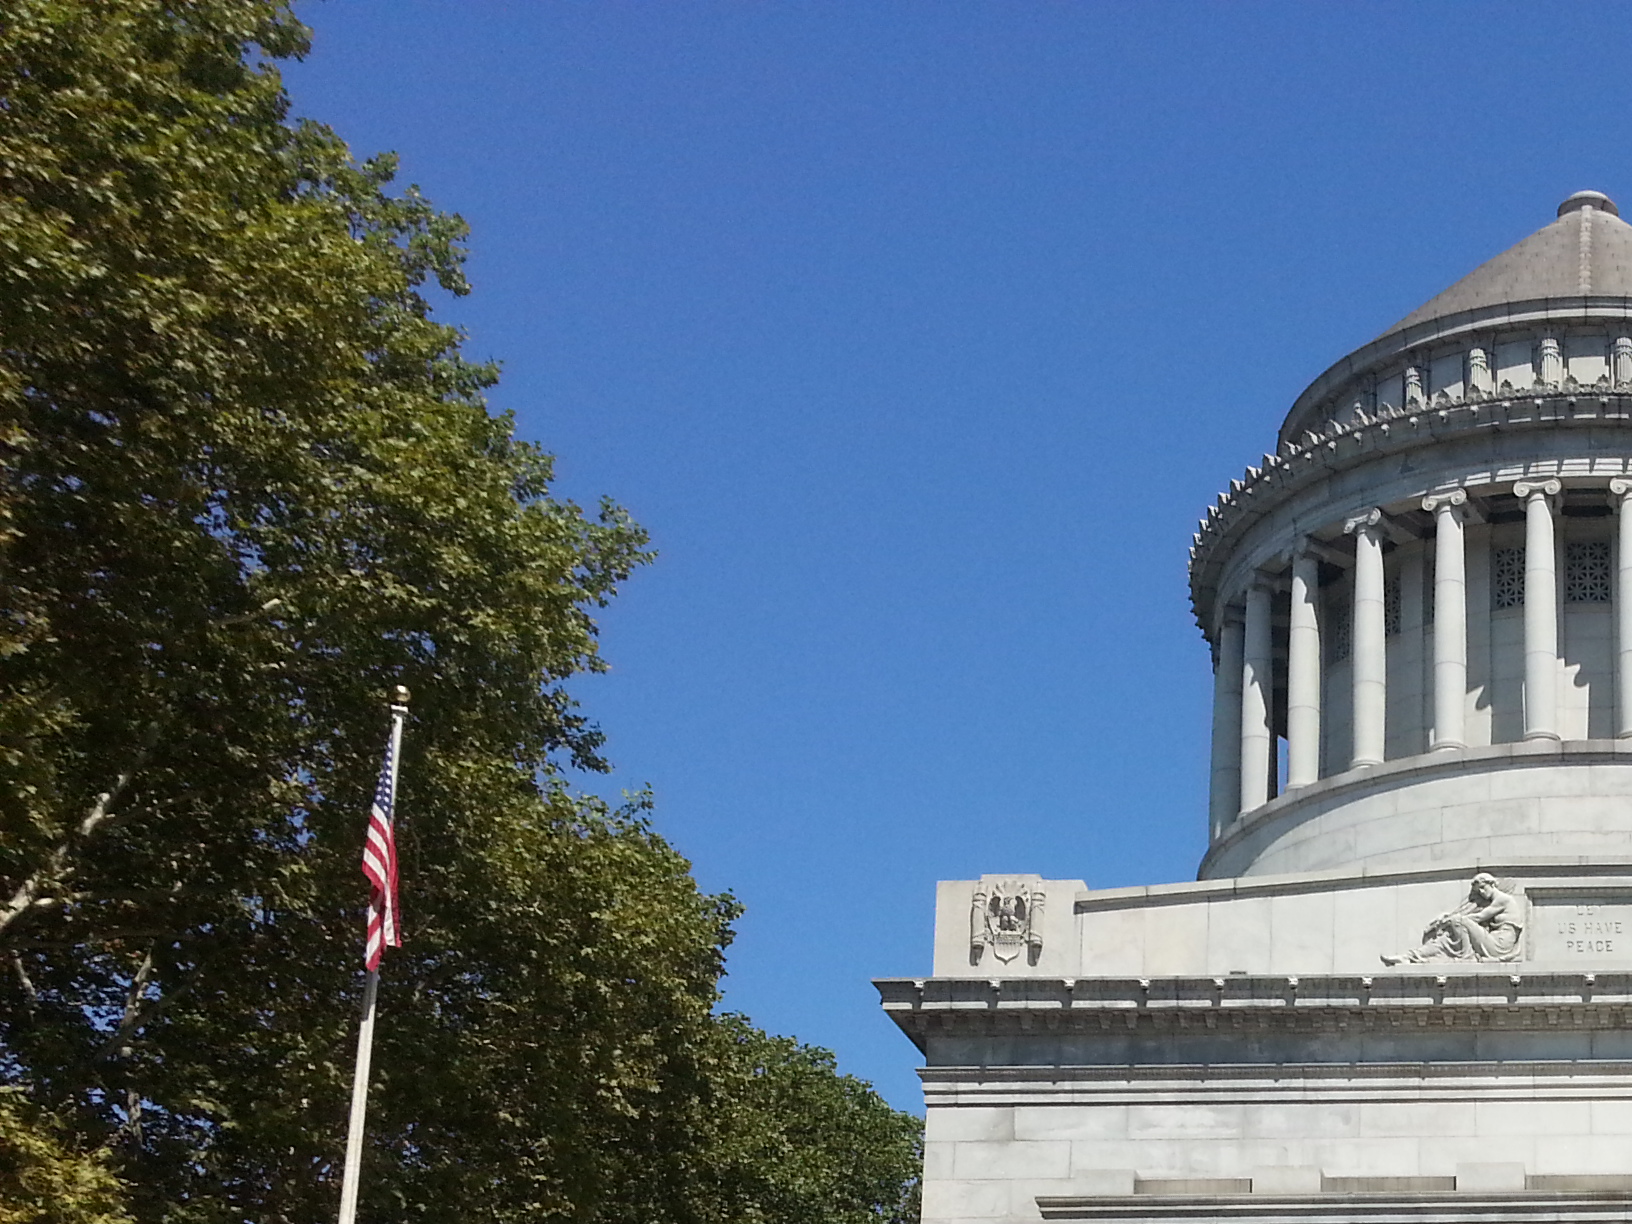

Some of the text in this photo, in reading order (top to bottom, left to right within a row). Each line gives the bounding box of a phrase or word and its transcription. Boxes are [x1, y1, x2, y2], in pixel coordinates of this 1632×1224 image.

[1558, 922, 1622, 935] US HAVE
[1566, 940, 1613, 953] PEACE
